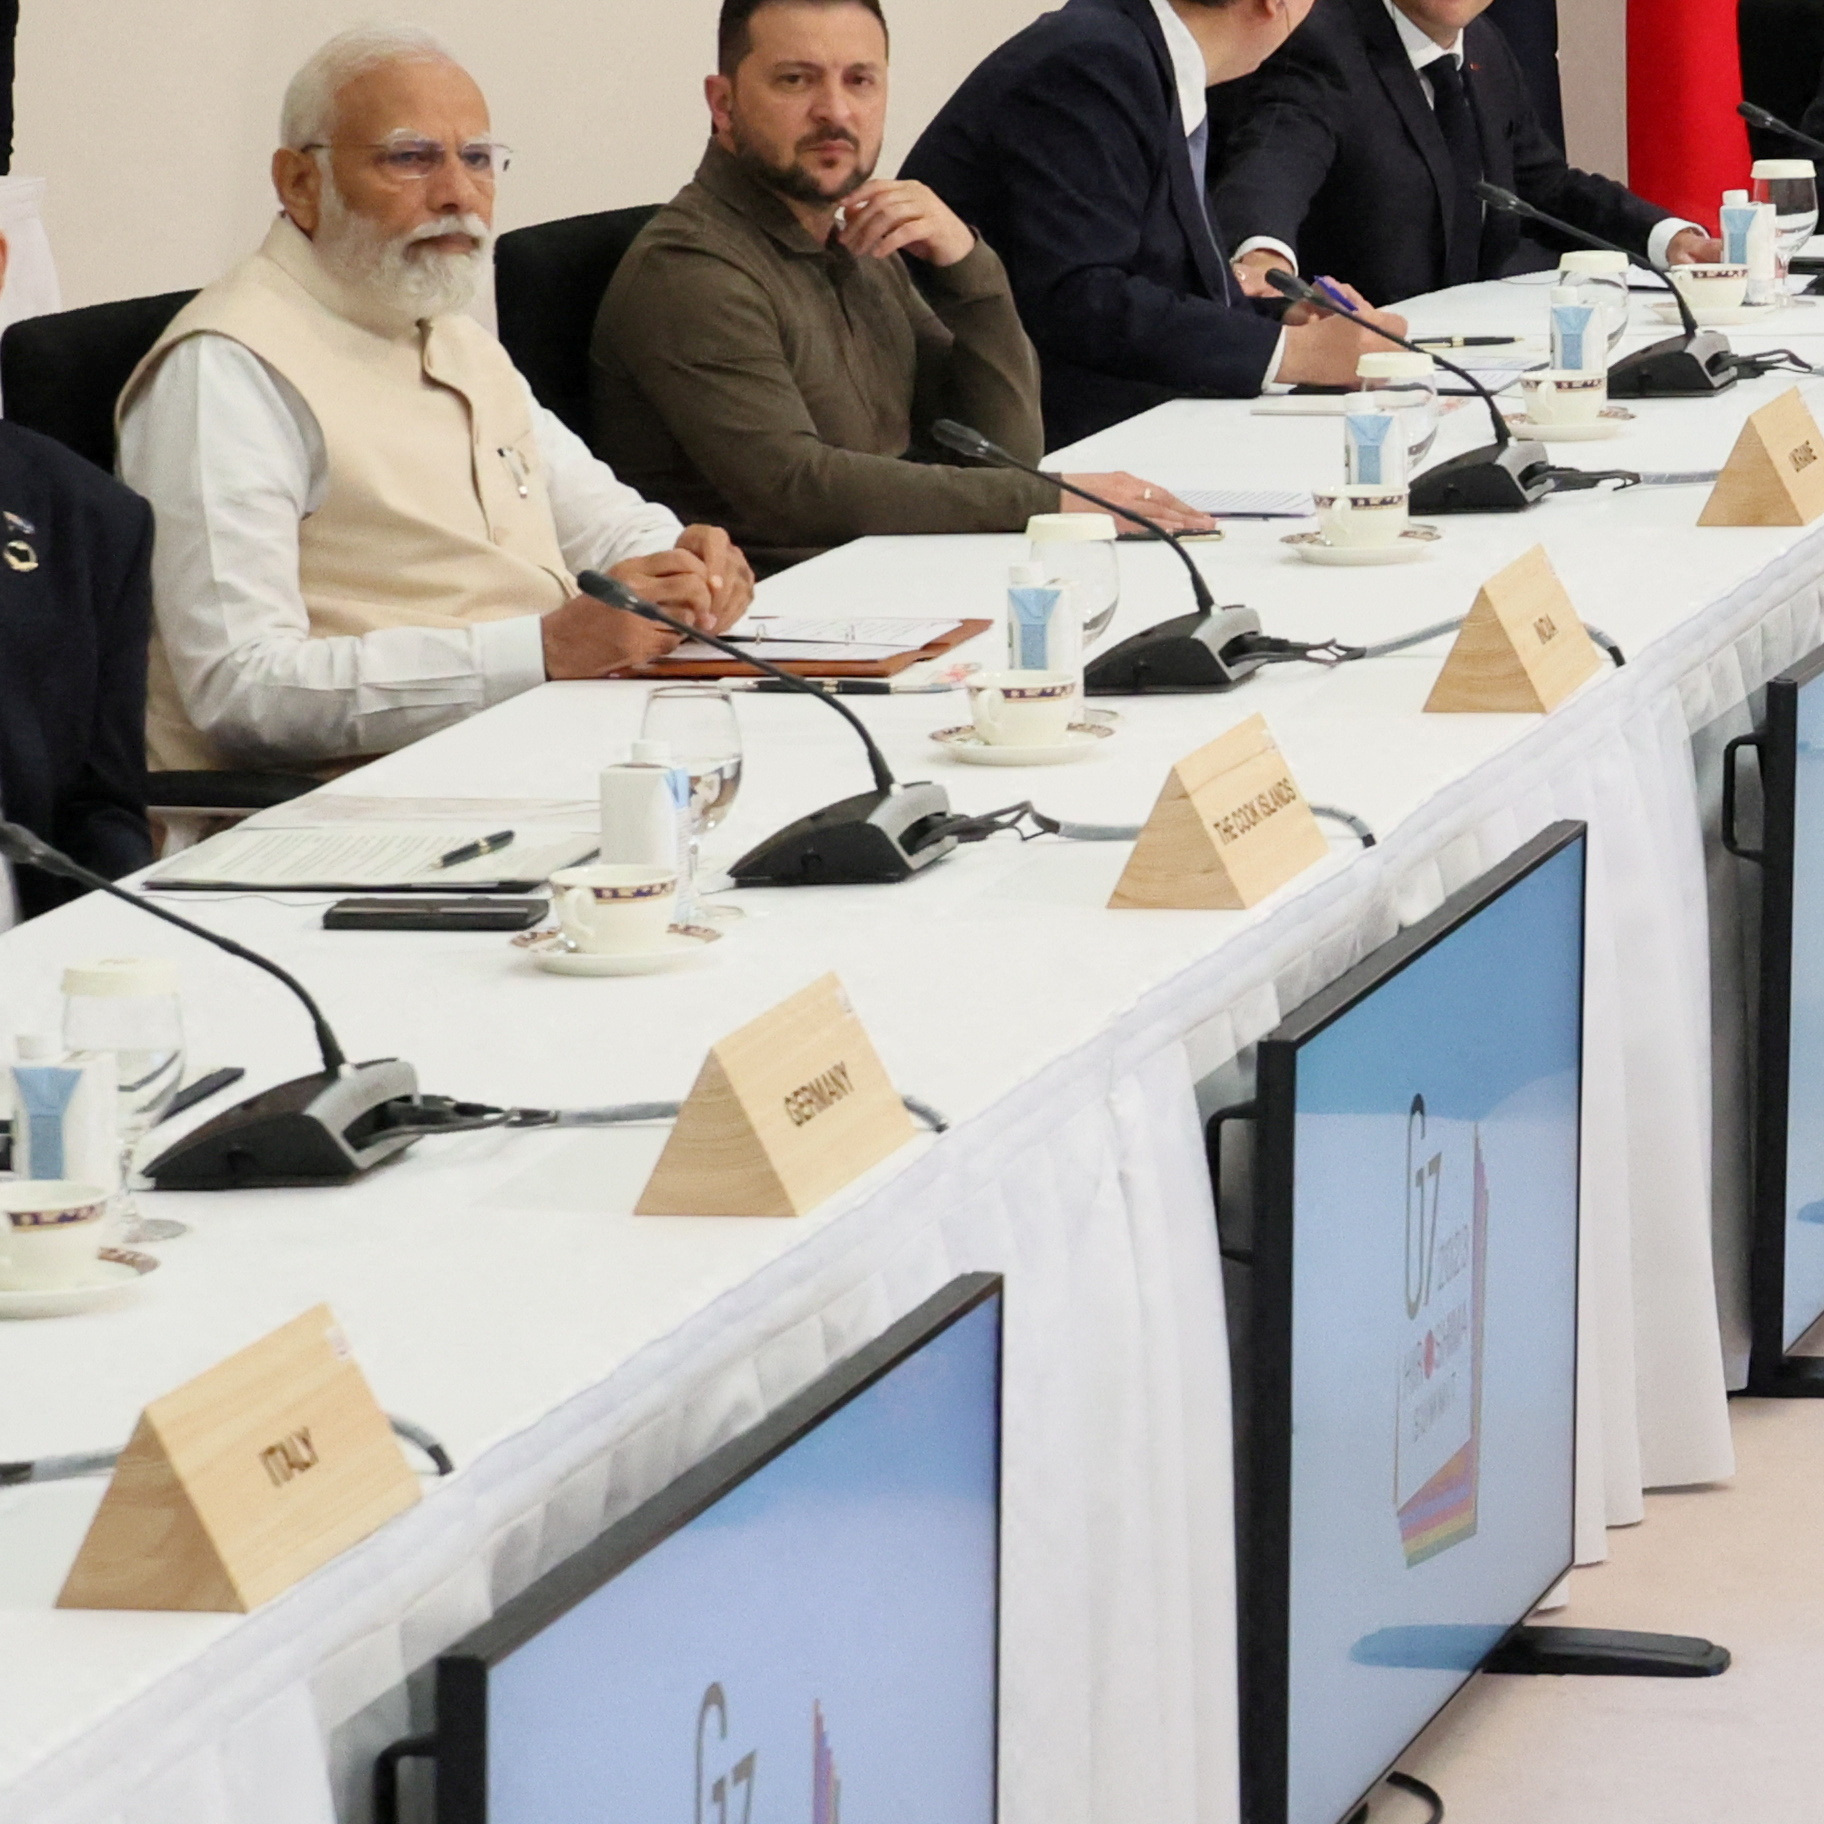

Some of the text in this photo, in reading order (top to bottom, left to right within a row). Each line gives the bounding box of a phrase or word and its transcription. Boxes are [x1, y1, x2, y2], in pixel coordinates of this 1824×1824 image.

[1212, 775, 1297, 847] THE COOK ISLANDS
[782, 1058, 856, 1129] GERMANY
[1404, 1091, 1443, 1322] G7
[257, 1425, 322, 1489] ITALY
